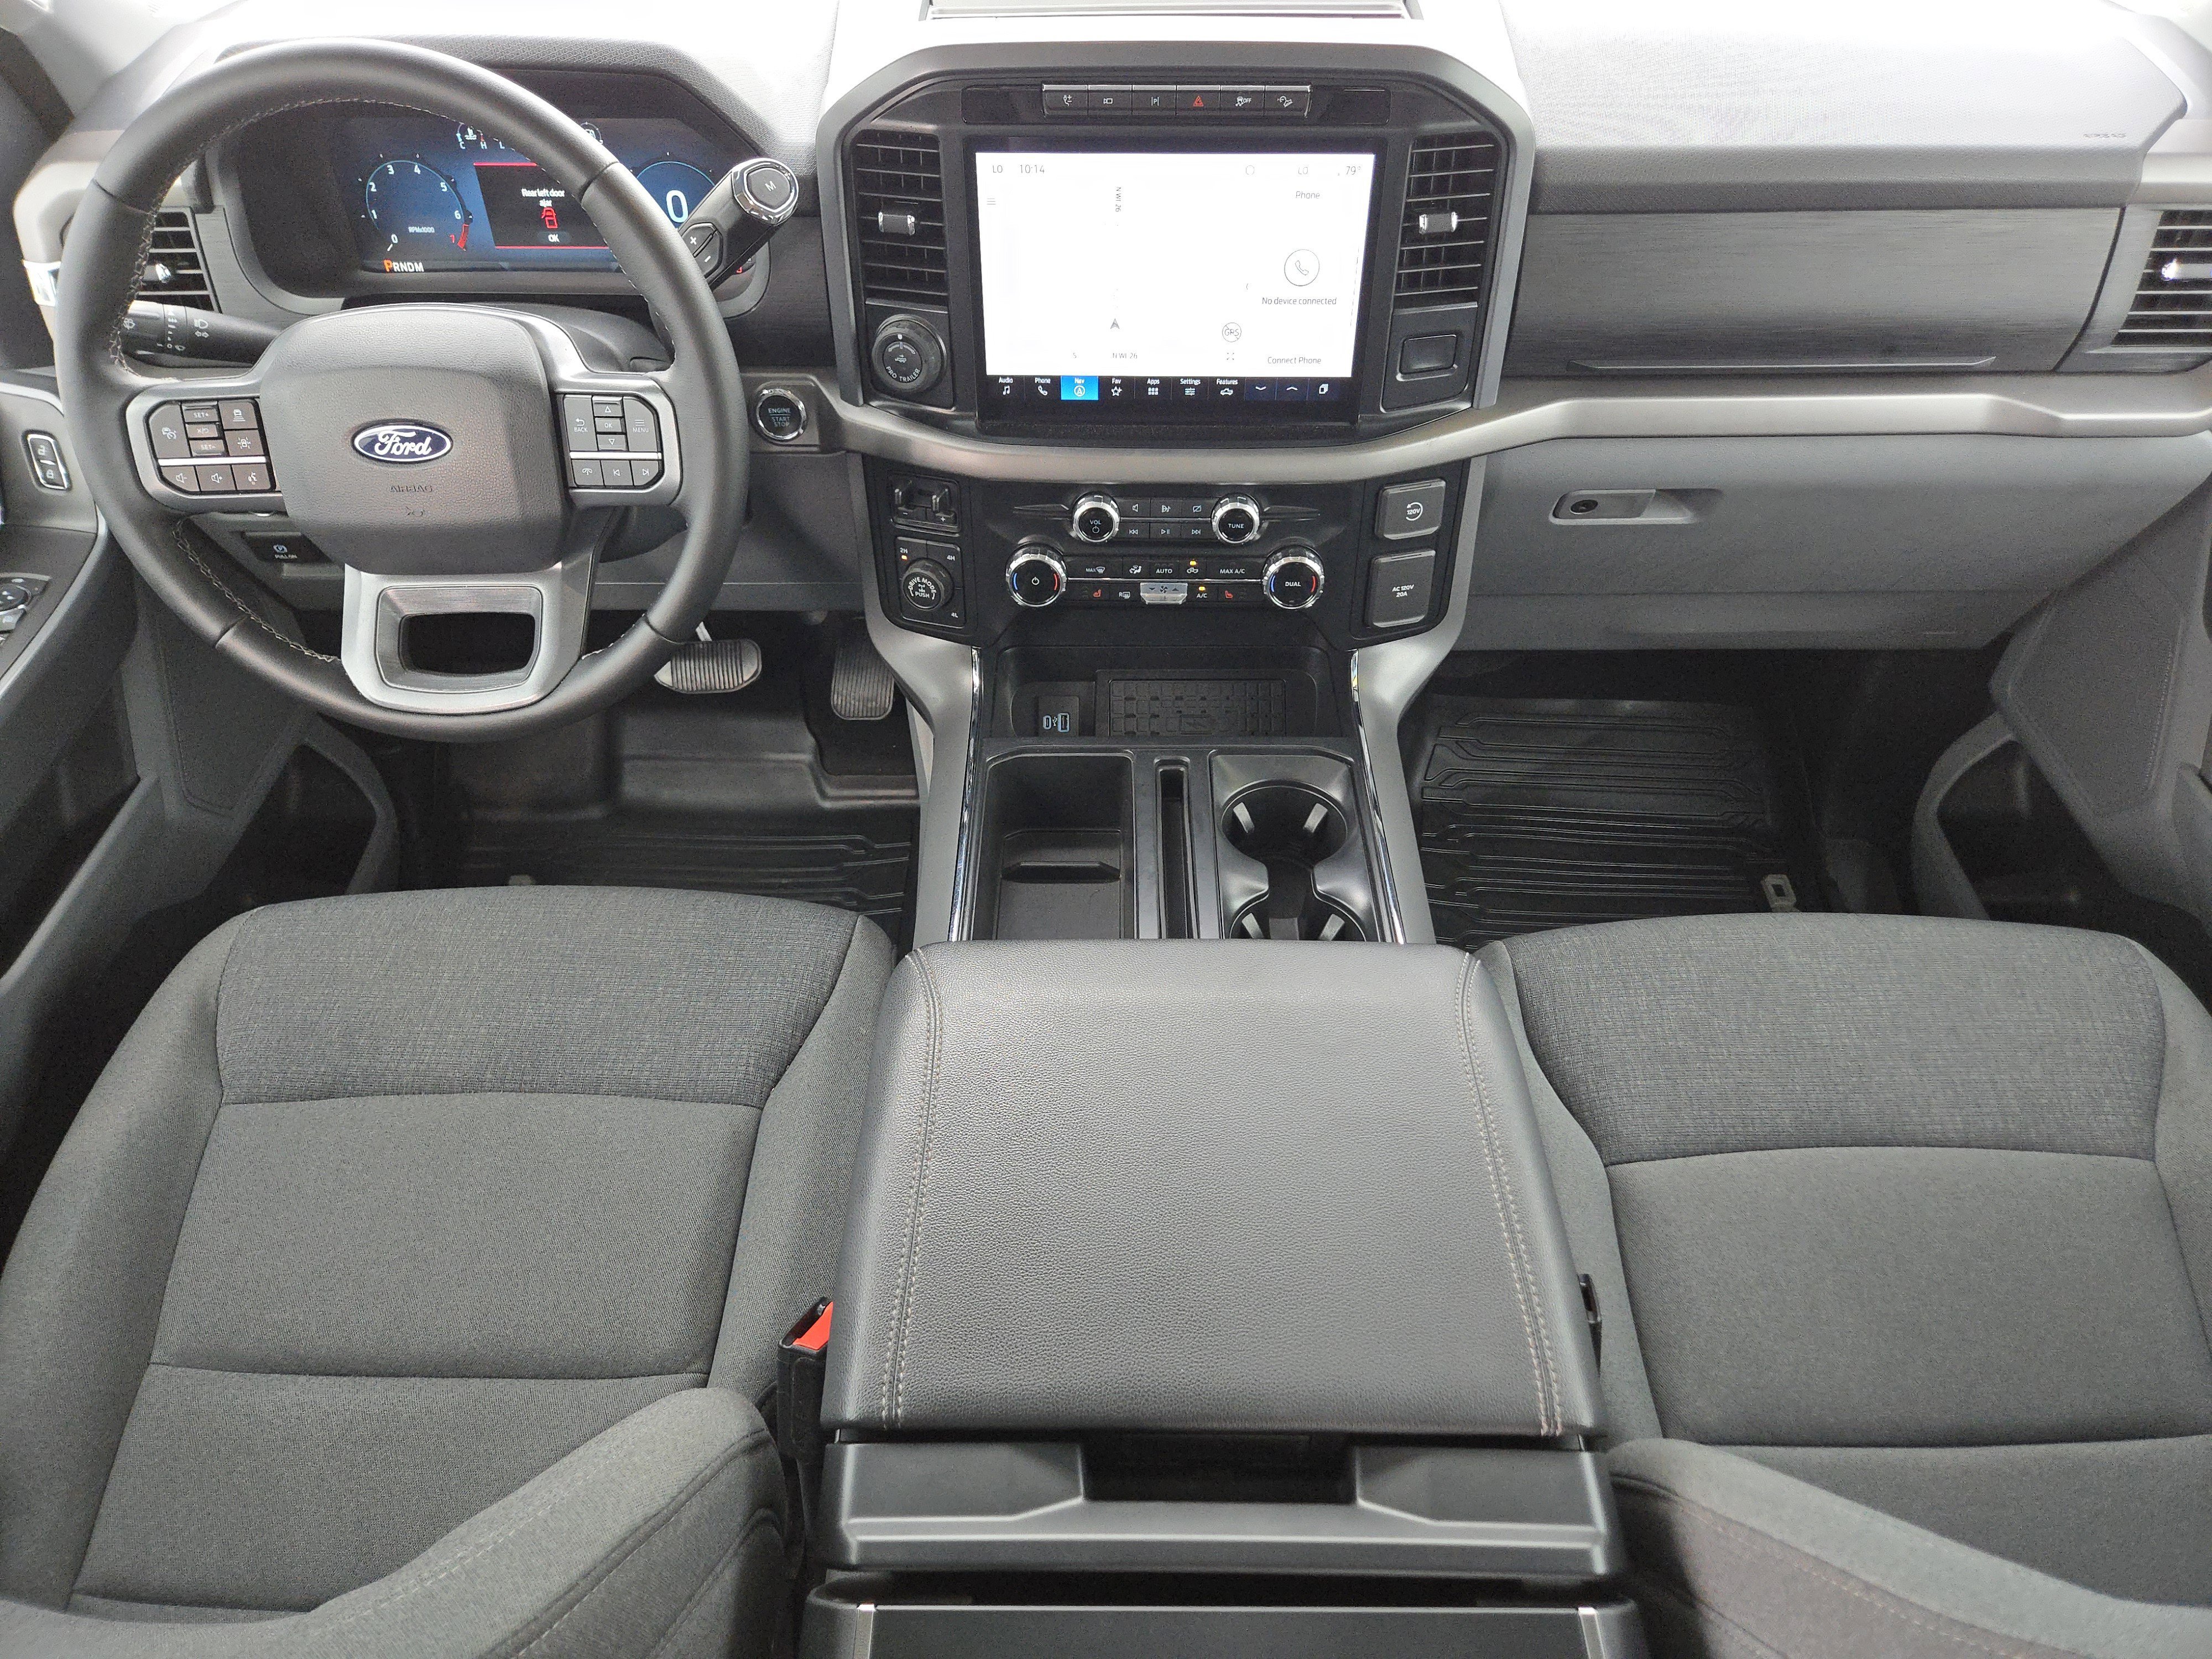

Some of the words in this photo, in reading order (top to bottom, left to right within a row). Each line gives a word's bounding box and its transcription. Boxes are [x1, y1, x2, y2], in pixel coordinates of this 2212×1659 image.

[387, 164, 394, 175] 3
[414, 164, 421, 175] 4
[992, 165, 1003, 173] LO
[1020, 164, 1045, 174] 10:14
[369, 182, 377, 192] 2
[440, 182, 447, 192] 5
[765, 181, 776, 191] M
[521, 188, 537, 197] Rear
[549, 189, 565, 197] door
[1295, 191, 1321, 199] Phone
[666, 190, 688, 223] 0
[372, 210, 378, 219] 1
[454, 210, 461, 220] 6
[391, 233, 398, 243] 0
[449, 234, 455, 243] 7
[548, 234, 560, 242] OK
[886, 366, 897, 379] PRO
[899, 368, 921, 382] TRAILER
[374, 430, 432, 456] Ford
[907, 577, 921, 590] DRIVE
[921, 577, 937, 593] MODE
